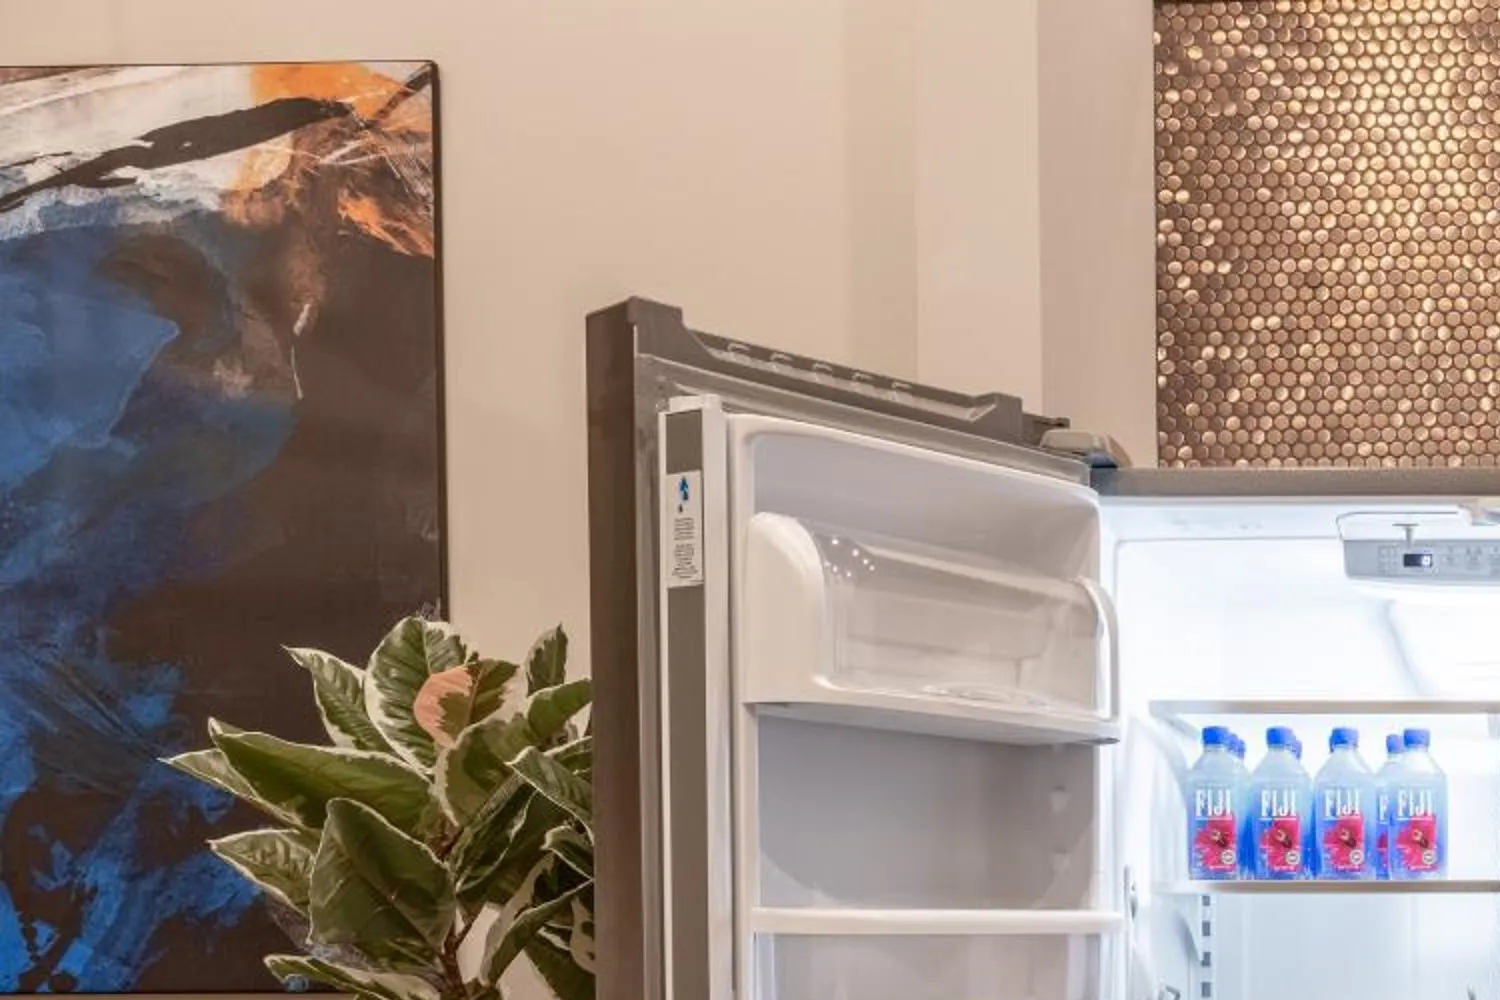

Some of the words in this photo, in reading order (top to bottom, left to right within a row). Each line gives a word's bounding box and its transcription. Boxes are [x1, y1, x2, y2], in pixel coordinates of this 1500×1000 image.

[1195, 789, 1231, 817] FIJI
[1261, 789, 1296, 817] FIJI
[1325, 789, 1360, 817] FIJI
[1397, 789, 1432, 817] FIJI
